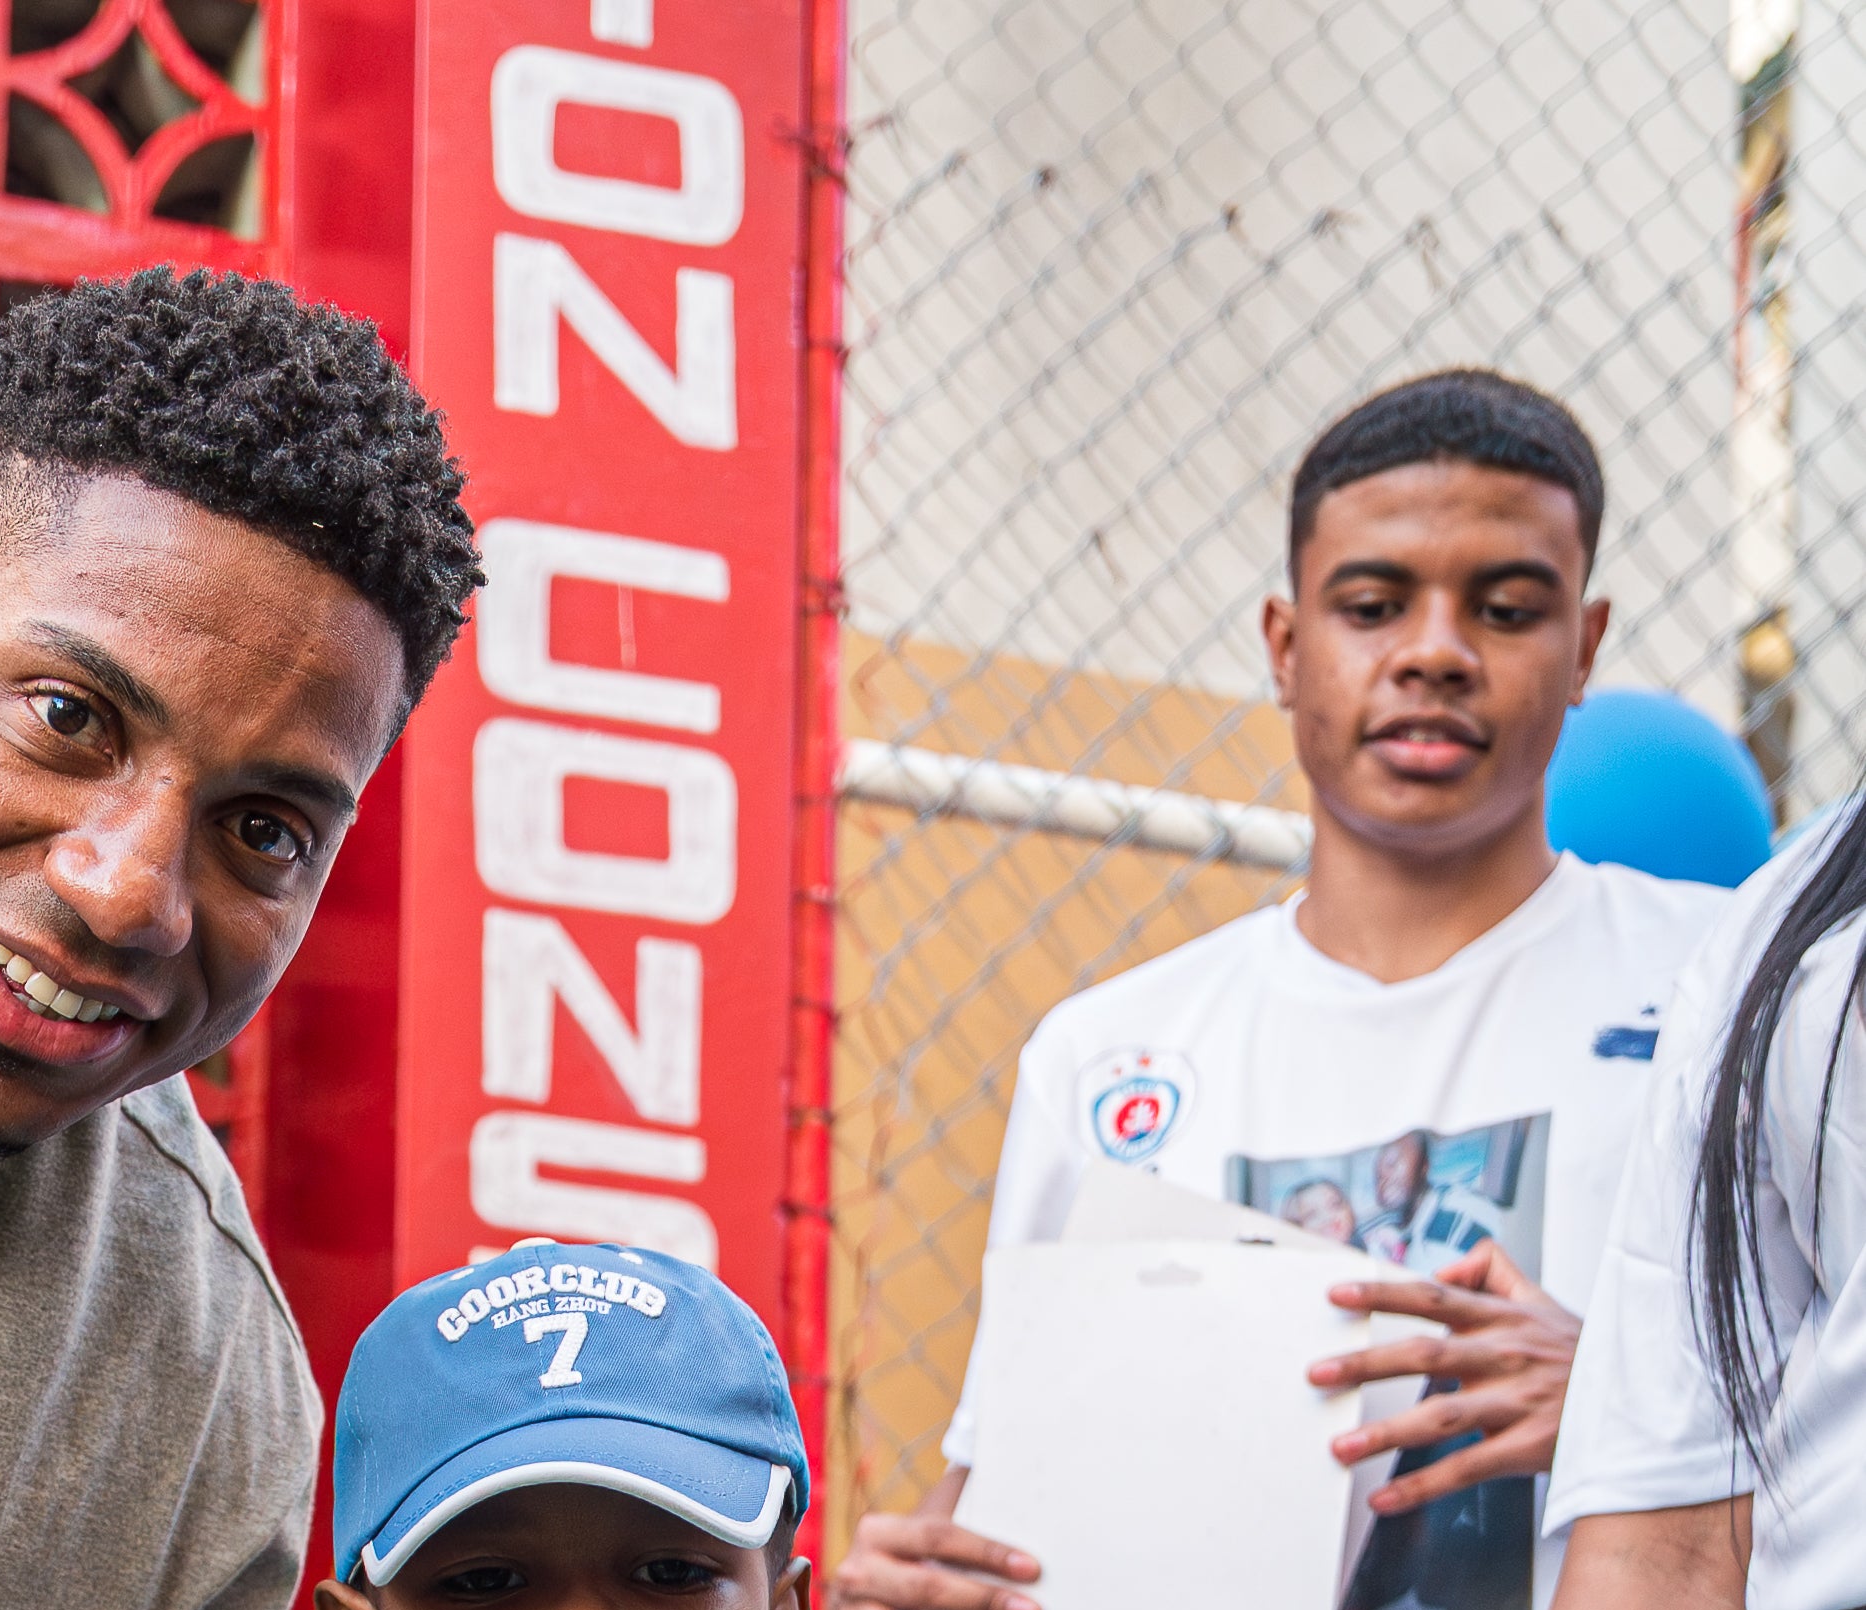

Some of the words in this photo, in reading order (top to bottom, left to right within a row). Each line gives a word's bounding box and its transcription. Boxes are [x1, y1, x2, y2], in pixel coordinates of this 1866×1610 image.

[490, 0, 746, 452] ON
[437, 1264, 667, 1342] COORCLUB
[491, 1297, 550, 1329] HANG
[554, 1296, 612, 1315] ZHOU
[524, 1312, 588, 1389] 7
